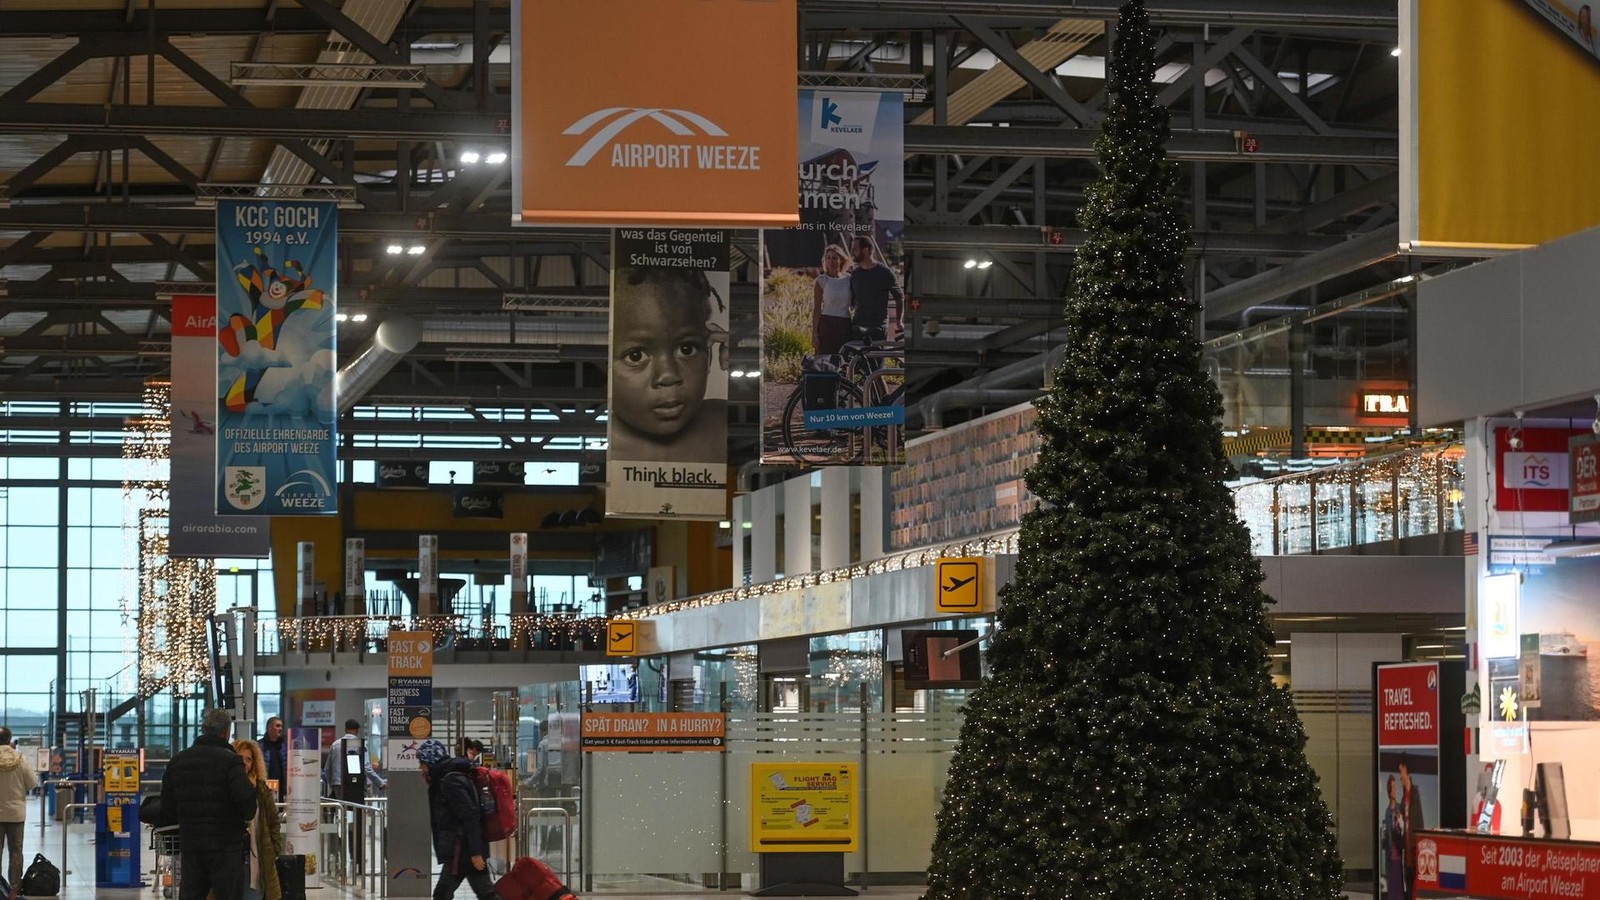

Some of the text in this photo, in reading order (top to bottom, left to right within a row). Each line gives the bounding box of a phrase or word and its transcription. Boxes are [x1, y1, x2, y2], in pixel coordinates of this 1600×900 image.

[831, 126, 863, 134] KEVELAER
[611, 143, 761, 171] AIRPORT WEEZE
[798, 158, 858, 182] urch
[798, 191, 861, 210] men
[235, 205, 319, 229] KCC GOCH
[816, 221, 826, 231] in
[245, 231, 310, 245] 1994 e.V.
[646, 229, 666, 241] das
[669, 229, 724, 245] Gegenteil
[655, 242, 693, 255] ist von
[630, 253, 718, 269] Schwarzsehen?
[809, 411, 894, 423] Nur 10 km von Weeze!
[224, 428, 330, 441] OFFIZIELLE EHRENGARDE
[234, 443, 320, 454] DES AIRPORT WEEZE
[777, 445, 842, 454] www.kevelaer.de
[622, 466, 717, 484] Think black.
[1523, 465, 1550, 480] ITS
[281, 498, 326, 508] WEEZE
[182, 523, 258, 534] airarabia.com
[390, 640, 415, 654] FAST
[390, 656, 423, 669] TRACK
[389, 688, 420, 697] BUSINESS
[1383, 687, 1414, 706] TRAVEL
[389, 696, 406, 705] PLUS
[389, 708, 405, 716] FAST
[389, 716, 410, 725] TRACK
[585, 716, 722, 733] SPÄT DRAN? IN A HURRY?
[1384, 711, 1433, 731] REFRESHED.
[1481, 845, 1498, 865] Seit
[1498, 847, 1523, 867] 2003
[1524, 848, 1541, 868] der
[1501, 872, 1585, 898] am Airport Weeze!
